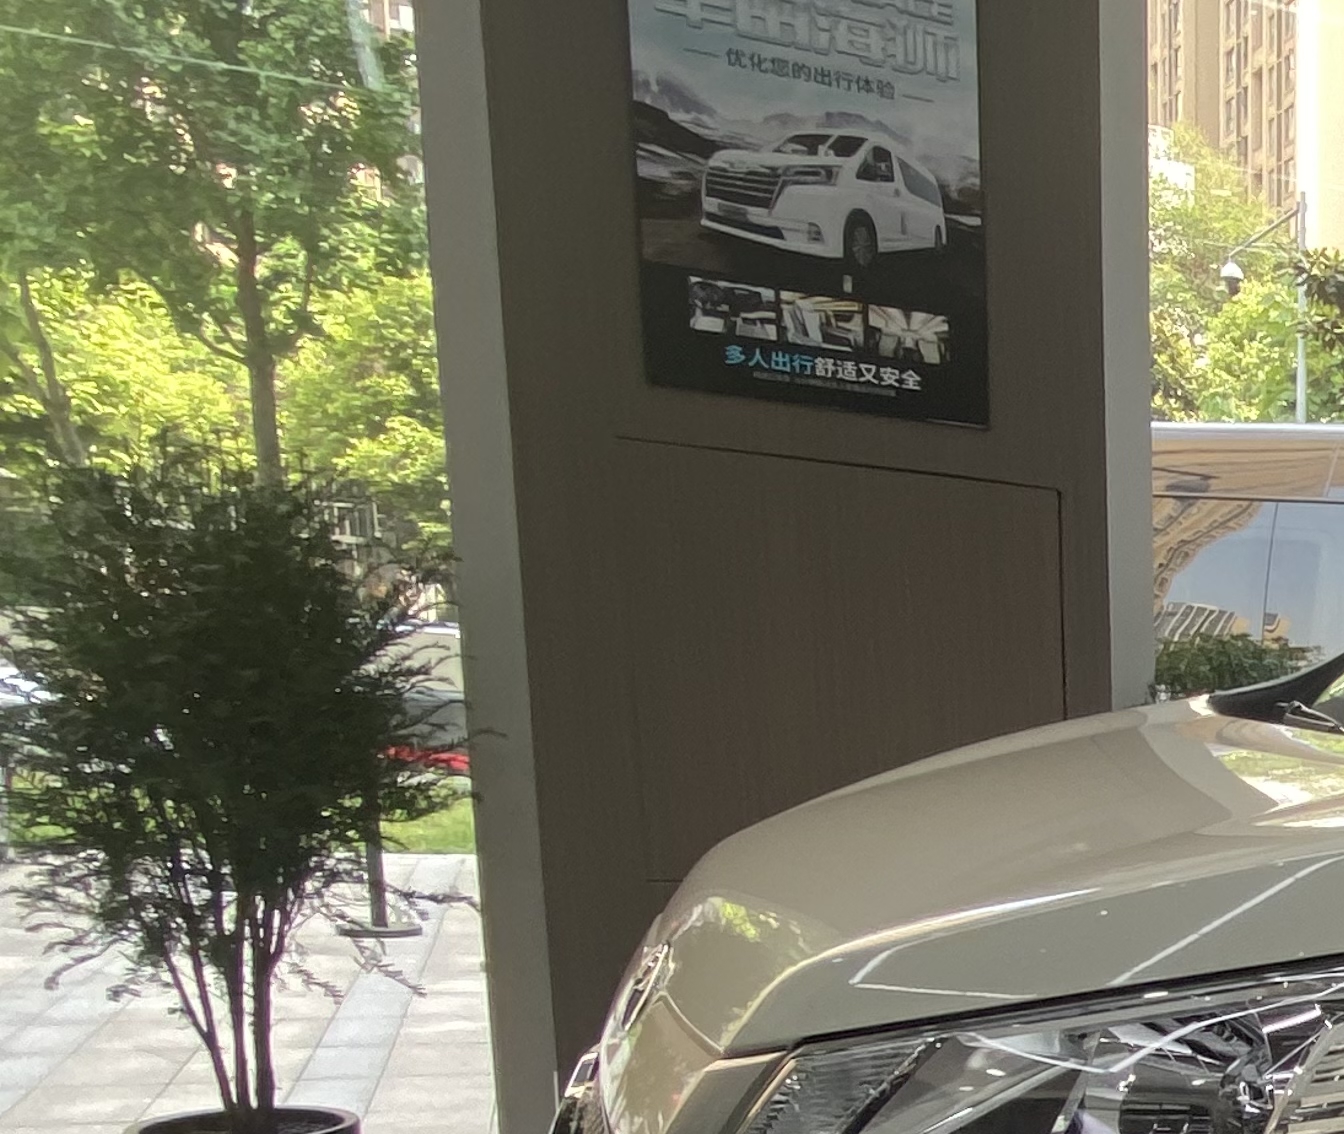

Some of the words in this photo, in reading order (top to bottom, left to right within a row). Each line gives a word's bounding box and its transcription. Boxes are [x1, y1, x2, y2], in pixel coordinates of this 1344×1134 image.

[725, 48, 895, 100] 优化您的出行体验
[724, 344, 922, 391] 多人出行舒适又安全
